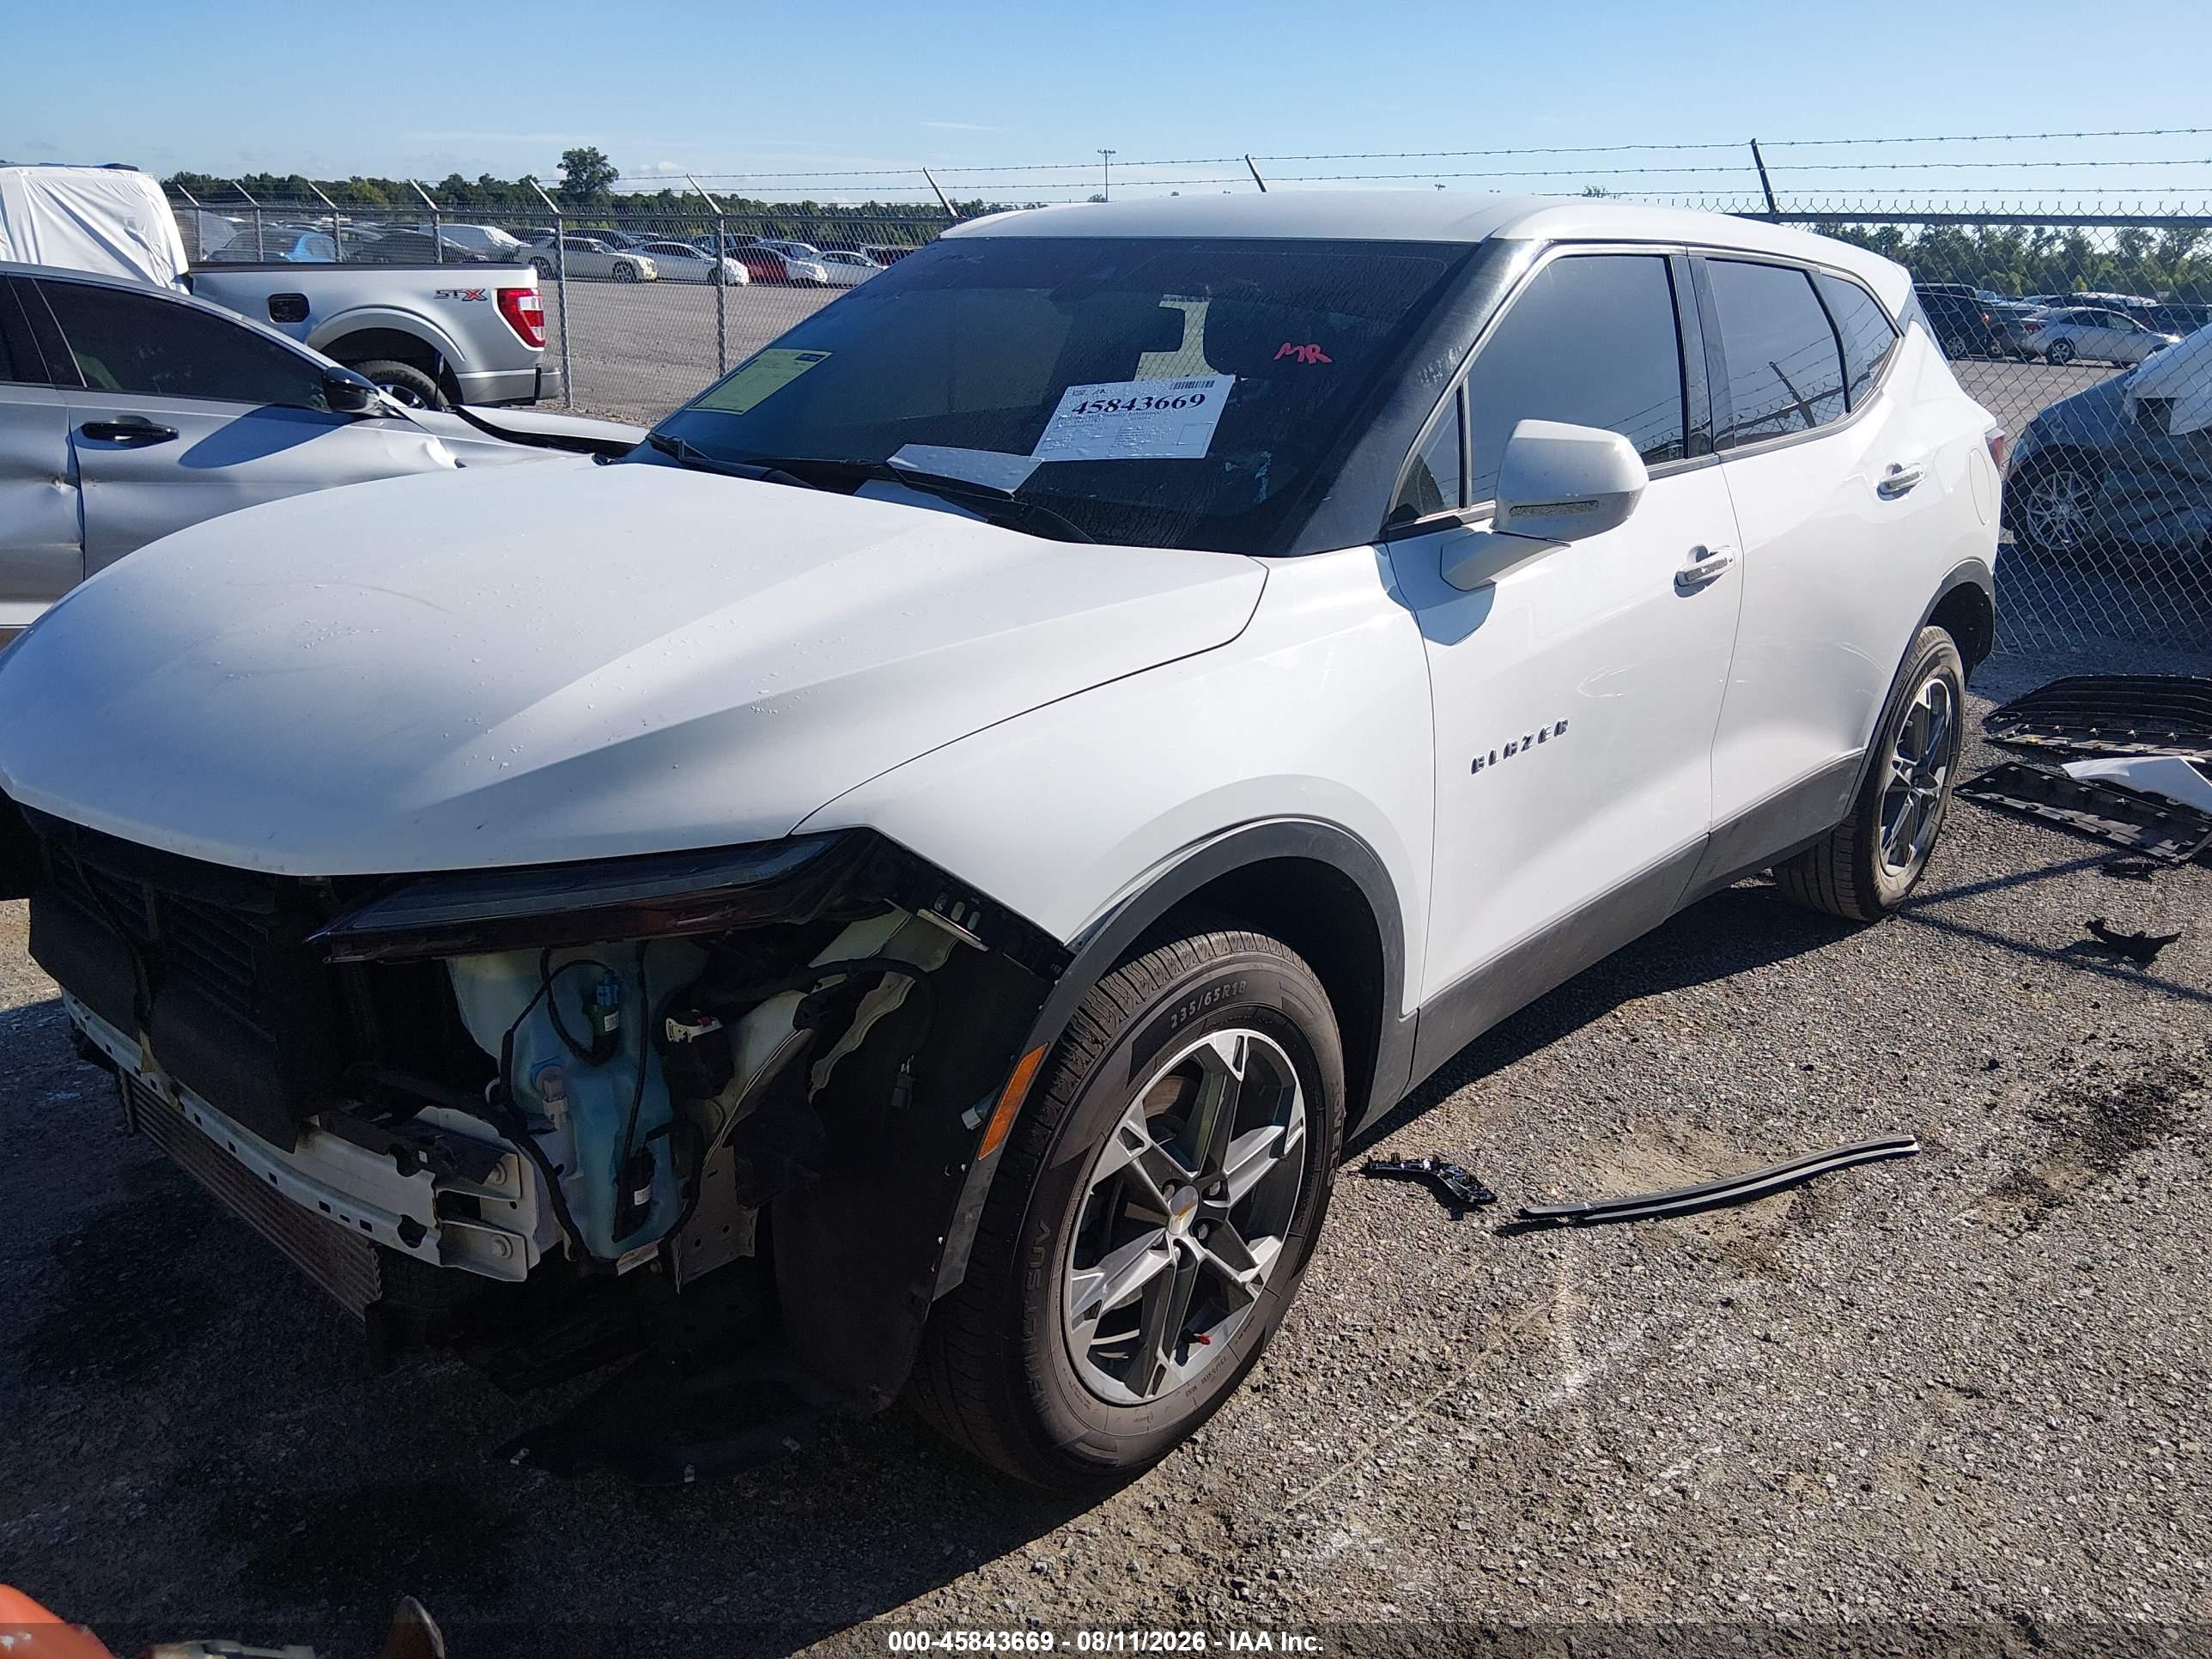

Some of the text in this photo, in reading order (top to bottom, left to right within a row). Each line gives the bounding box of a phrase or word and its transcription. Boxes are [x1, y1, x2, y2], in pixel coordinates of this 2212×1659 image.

[434, 289, 488, 301] STX
[1273, 343, 1332, 364] MR
[1072, 393, 1206, 415] 45843669
[1471, 718, 1569, 775] BLAZER
[1170, 981, 1247, 1030] 235/65R18
